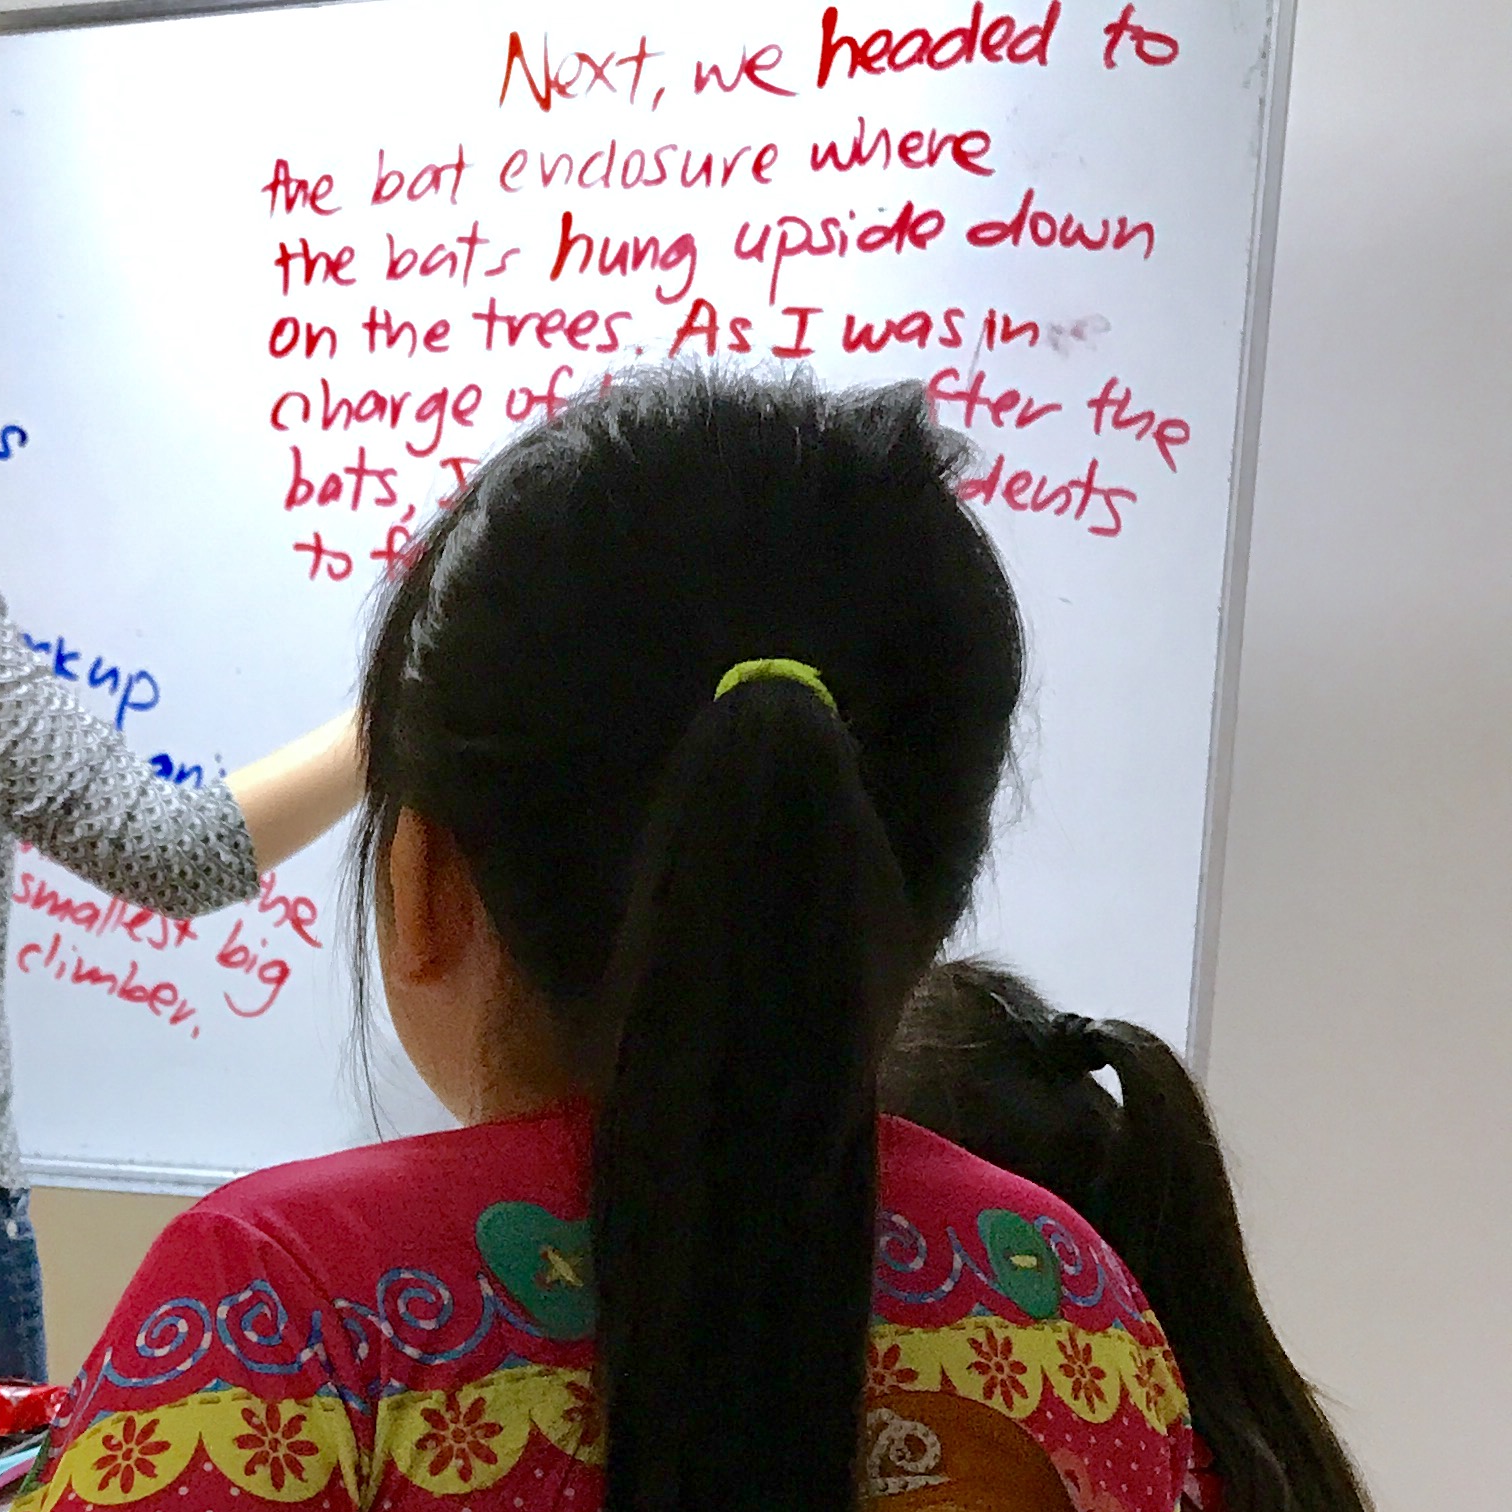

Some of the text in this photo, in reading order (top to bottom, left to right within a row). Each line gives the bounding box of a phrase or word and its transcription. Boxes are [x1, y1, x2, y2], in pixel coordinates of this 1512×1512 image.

[500, 0, 1178, 112] Next, we headed to
[262, 117, 993, 216] the bat enclosure where
[274, 189, 1154, 305] the bats hung upside down
[268, 299, 1039, 359] on the trees. As I was in
[270, 376, 482, 458] charge
[506, 365, 573, 421] of
[926, 368, 1190, 476] fter the
[285, 444, 417, 523] bats,
[957, 455, 1136, 536] dents
[294, 532, 353, 581] to
[13, 873, 291, 1017] smallest big
